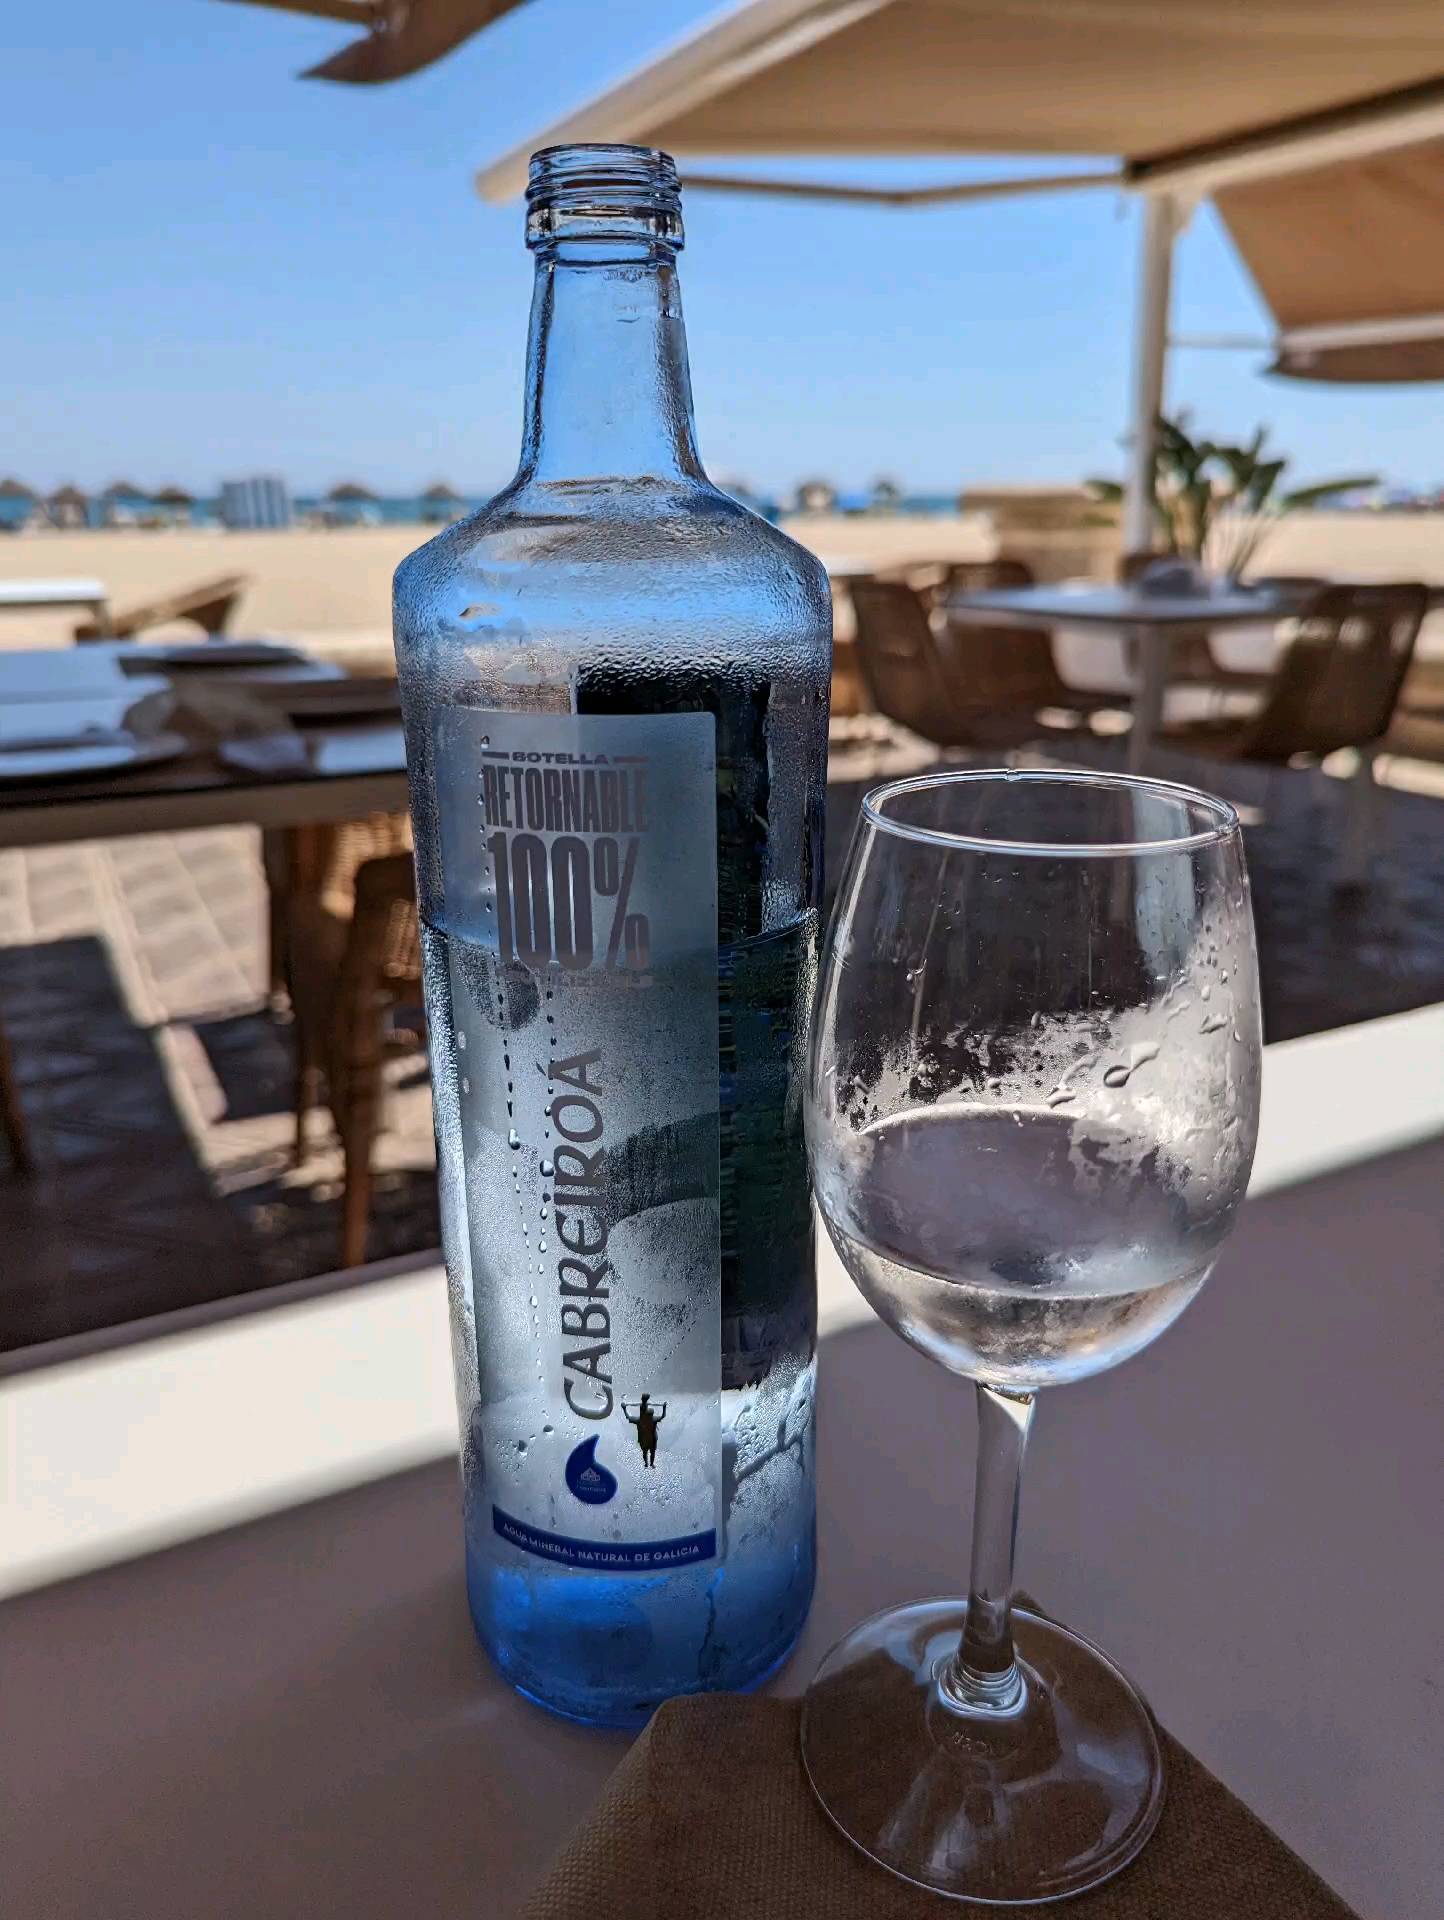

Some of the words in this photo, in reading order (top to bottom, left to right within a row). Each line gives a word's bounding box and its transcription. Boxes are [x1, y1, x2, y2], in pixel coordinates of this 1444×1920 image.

[511, 751, 609, 765] BOTELLA
[483, 764, 649, 833] RETORNABLE
[487, 831, 650, 971] 100%
[536, 1048, 613, 1420] CABREIROÁ
[503, 1523, 529, 1544] AGUA
[529, 1538, 575, 1557] MINERAL
[578, 1551, 631, 1562] NATURAL
[635, 1552, 650, 1562] DE
[653, 1545, 700, 1561] GALICIA
